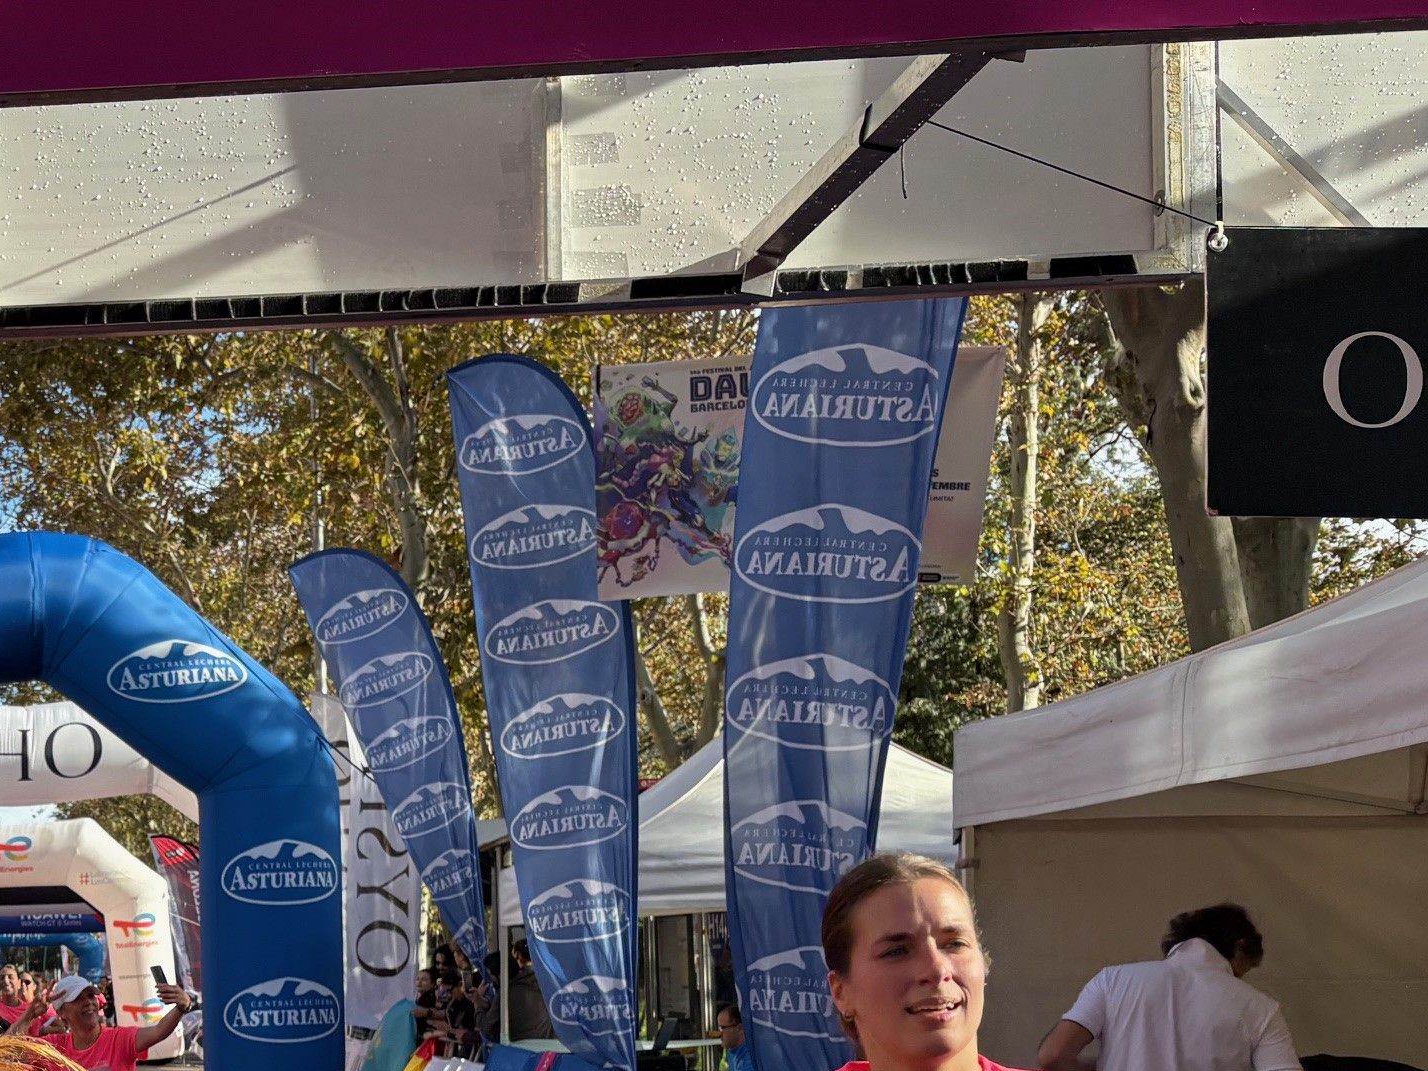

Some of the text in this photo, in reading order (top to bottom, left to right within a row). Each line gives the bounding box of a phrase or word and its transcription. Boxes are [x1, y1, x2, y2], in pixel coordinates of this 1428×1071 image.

[1322, 330, 1424, 429] O
[690, 399, 746, 413] BARCELO
[932, 481, 971, 491] EMBRE
[138, 660, 184, 671] CENTRAL
[118, 666, 239, 691] ASTURIANA
[248, 862, 292, 870] CENTRAL
[230, 866, 333, 891] ASTURIANA
[250, 1000, 294, 1008] CENTRAL
[232, 1002, 336, 1027] ASTURIANA
